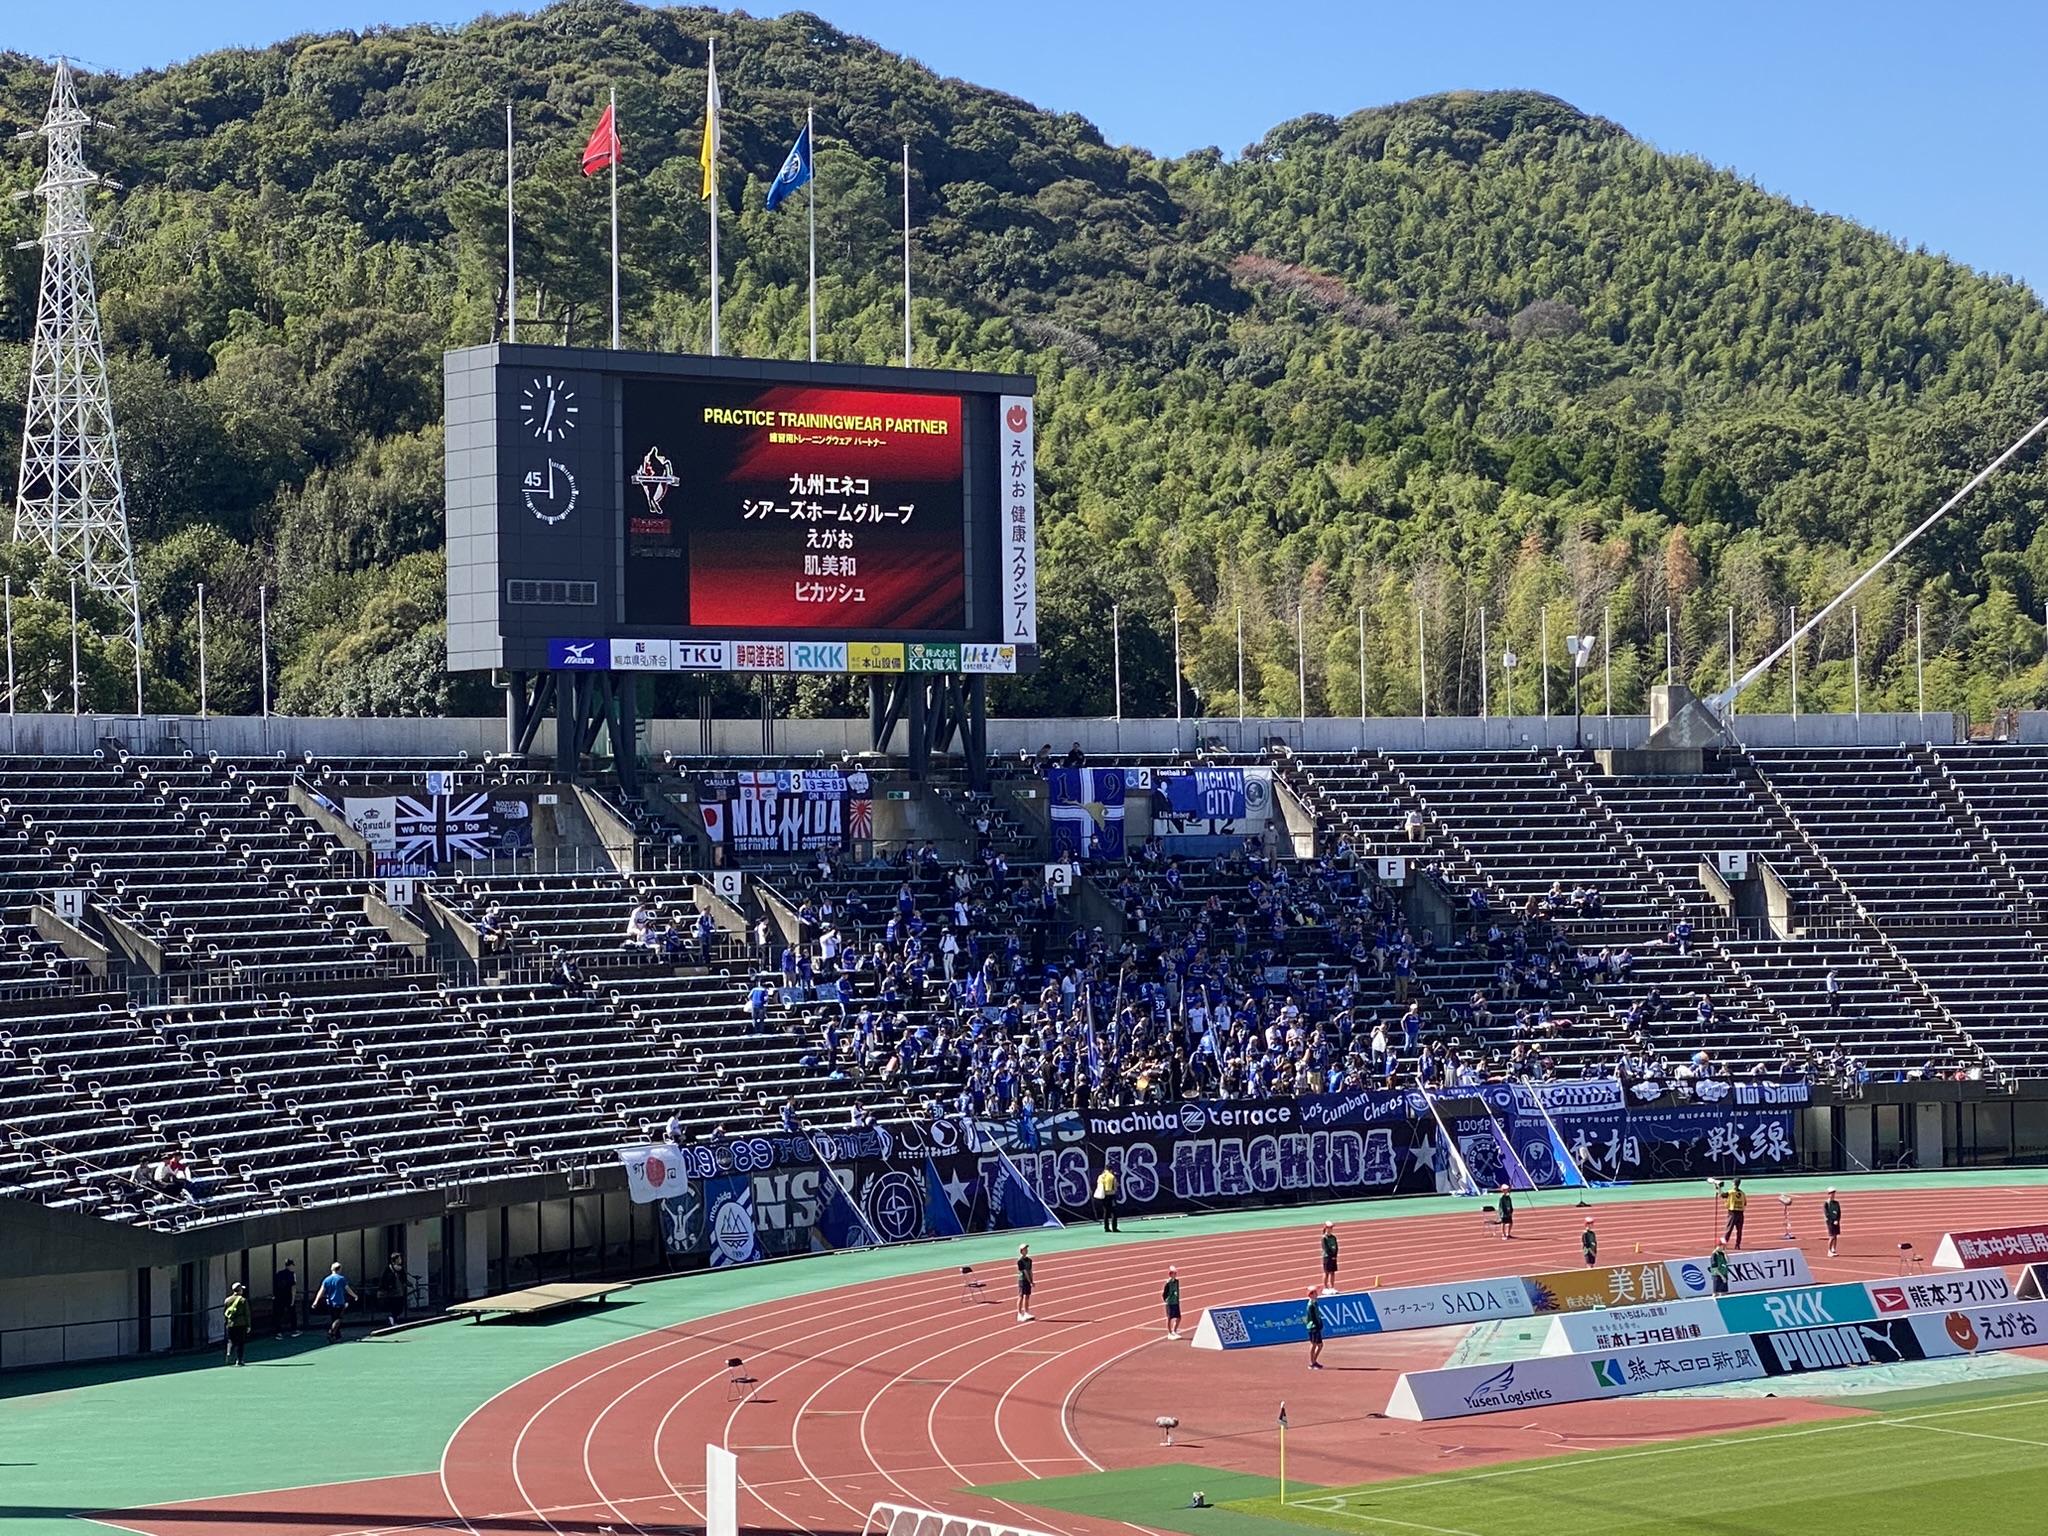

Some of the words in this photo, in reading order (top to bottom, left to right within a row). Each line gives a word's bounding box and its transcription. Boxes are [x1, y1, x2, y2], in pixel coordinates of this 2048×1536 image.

[704, 408, 775, 426] PRACTICE
[778, 412, 882, 432] TRAININGWEAR
[885, 418, 948, 435] PARTNER
[854, 436, 887, 447] パートナー
[524, 471, 542, 487] 45
[1010, 439, 1027, 499] えがお
[789, 473, 869, 496] 九州エネコ
[742, 499, 915, 525] シアーズホームグループ
[806, 528, 854, 549] えがお
[804, 555, 857, 577] 肌美和
[1011, 504, 1029, 637] 健康スタジアム
[679, 648, 722, 664] TKU
[794, 645, 843, 668] RKK
[908, 657, 957, 671] KR電気
[926, 649, 957, 659] 株式会社
[443, 774, 452, 793] 4
[704, 779, 736, 787] CASUALS
[792, 773, 801, 790] 3
[805, 770, 840, 779] MACHIDA
[805, 780, 816, 790] 19
[832, 780, 844, 790] 89
[1140, 771, 1149, 787] 2
[1195, 771, 1244, 796] MACHIDA
[808, 792, 819, 800] ON
[822, 792, 841, 800] TOUR
[1103, 772, 1121, 801] 9
[1206, 789, 1235, 815] CITY
[400, 825, 415, 834] we
[419, 823, 437, 833] fear
[446, 823, 459, 832] no
[464, 822, 480, 832] foe
[731, 798, 842, 851] MACHIDA
[733, 837, 748, 851] THE
[1386, 861, 1397, 877] F
[1729, 855, 1738, 869] F
[722, 875, 734, 892] G
[1052, 867, 1064, 884] G
[63, 894, 75, 913] H
[394, 884, 405, 901] H
[1155, 1000, 1166, 1010] 39
[1519, 1084, 1618, 1109] MACHIDA
[1761, 1079, 1809, 1104] Siamo
[932, 1106, 944, 1118] 30
[1091, 1105, 1178, 1134] machida
[1207, 1106, 1291, 1127] terrace
[1322, 1091, 1370, 1125] Cumban
[1363, 1093, 1403, 1122] Cheros
[1570, 1128, 1642, 1171] 武相
[1703, 1120, 1794, 1165] 戦線
[681, 1145, 717, 1179] 19
[730, 1137, 774, 1172] 89
[1105, 1141, 1160, 1205] IS
[1170, 1128, 1398, 1199] MACHIDA
[709, 1191, 732, 1222] machida
[1958, 1232, 2048, 1260] 熊本中央信用
[1608, 1263, 1667, 1305] 美創
[1908, 1277, 2009, 1308] 熊本ダイハツ
[1318, 1301, 1376, 1327] AVAIL
[1383, 1302, 1435, 1316] オーダースーツ
[1441, 1289, 1503, 1316] SADA
[1763, 1290, 1835, 1328] RKK
[1596, 1323, 1702, 1350] 熊本トヨタ自動車
[1979, 1312, 2039, 1341] えがお
[1769, 1326, 1870, 1371] PUMA
[1627, 1348, 1758, 1383] 熊本日日新聞
[1463, 1394, 1501, 1409] Yusen
[1500, 1387, 1553, 1406] Logistics
